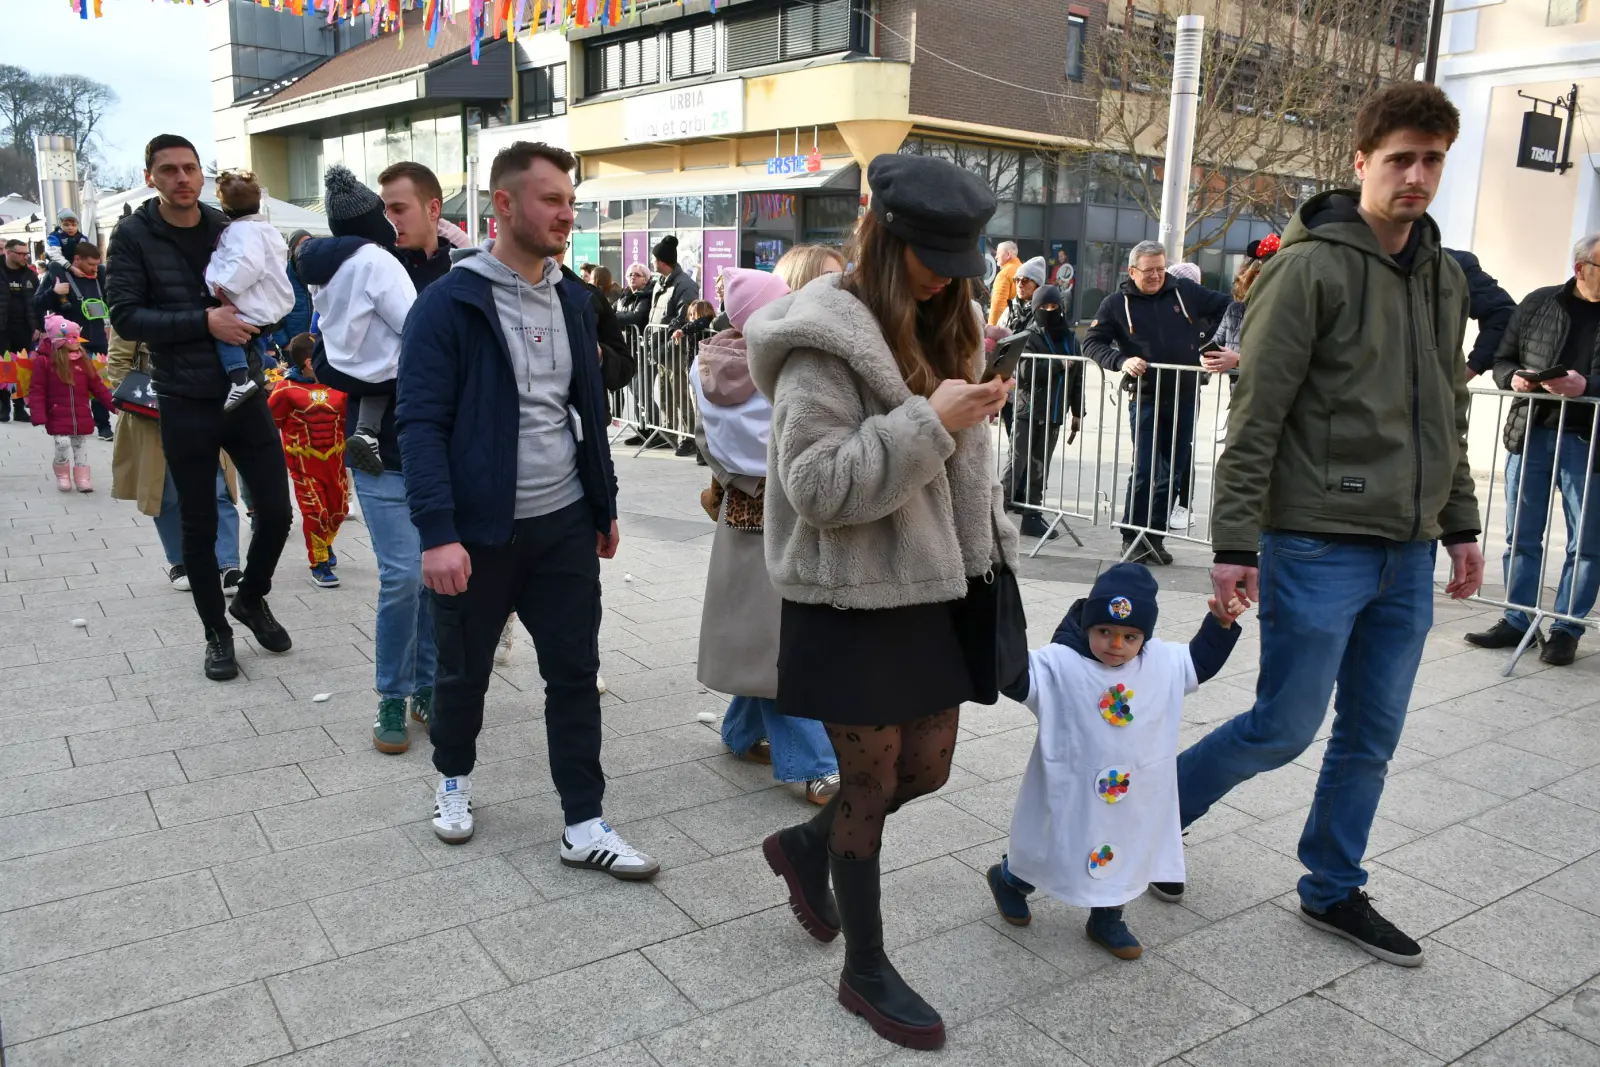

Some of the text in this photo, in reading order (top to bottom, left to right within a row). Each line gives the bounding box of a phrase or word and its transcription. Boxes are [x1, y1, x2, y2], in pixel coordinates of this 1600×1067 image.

[669, 90, 705, 111] URBIA
[711, 111, 729, 129] 25
[1530, 146, 1556, 163] TISAK
[767, 155, 806, 175] ERSTE
